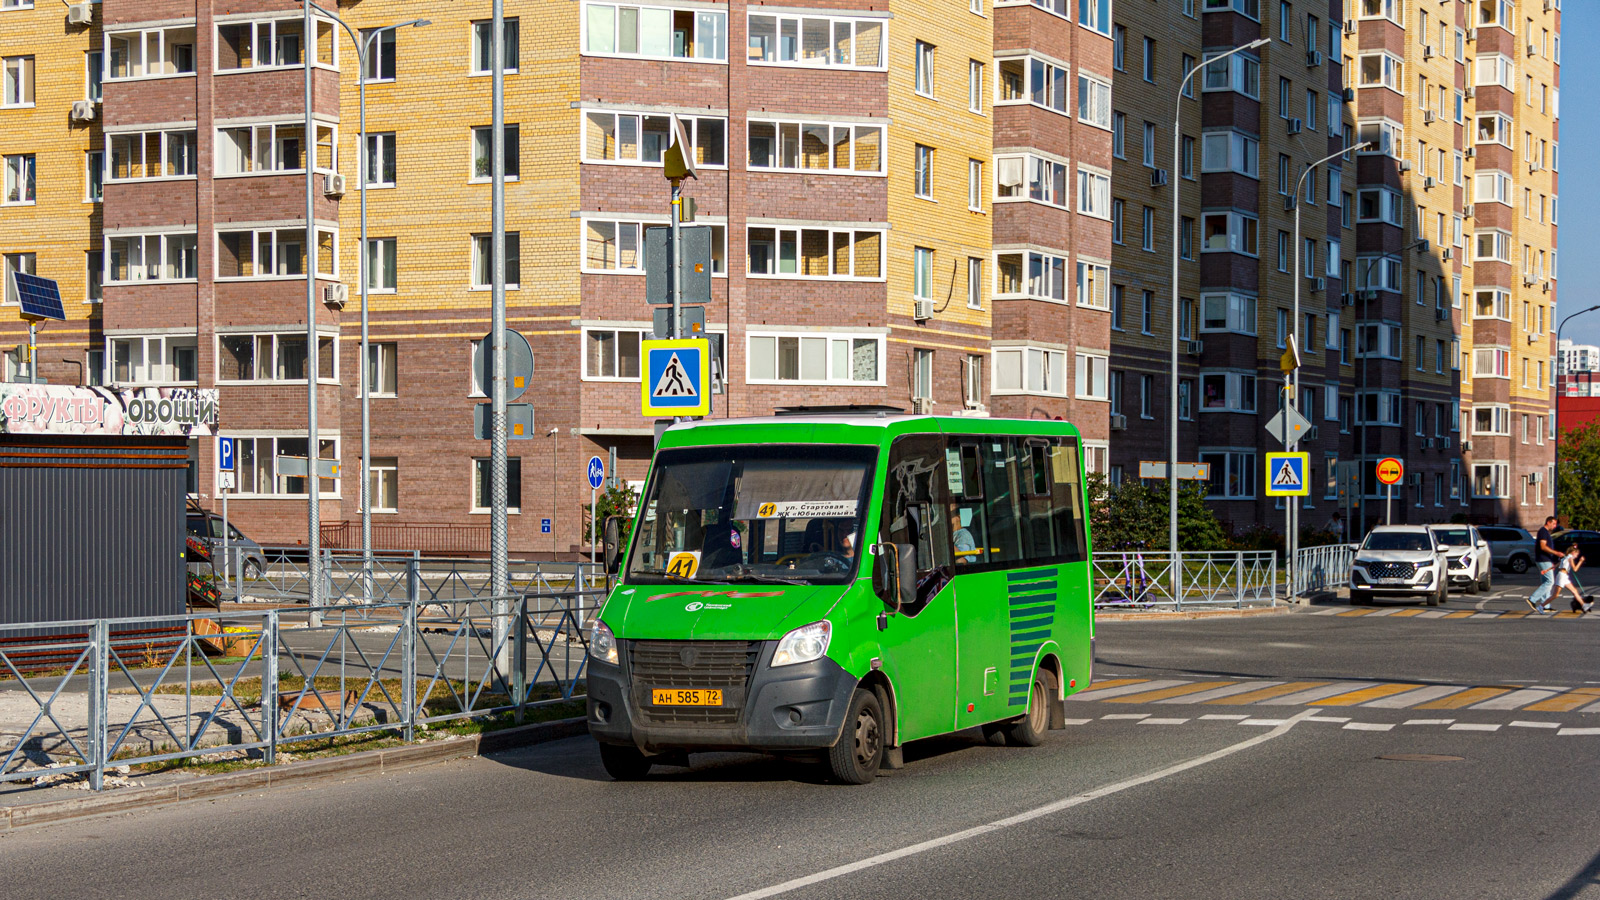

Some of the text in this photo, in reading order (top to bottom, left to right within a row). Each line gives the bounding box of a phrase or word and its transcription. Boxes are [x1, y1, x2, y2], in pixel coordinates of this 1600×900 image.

[3, 396, 214, 427] ФРУКТЫ ОВОЩИ
[222, 440, 232, 467] P
[760, 505, 775, 516] 41
[669, 559, 694, 578] 41
[677, 691, 700, 704] 585
[706, 690, 718, 701] 72
